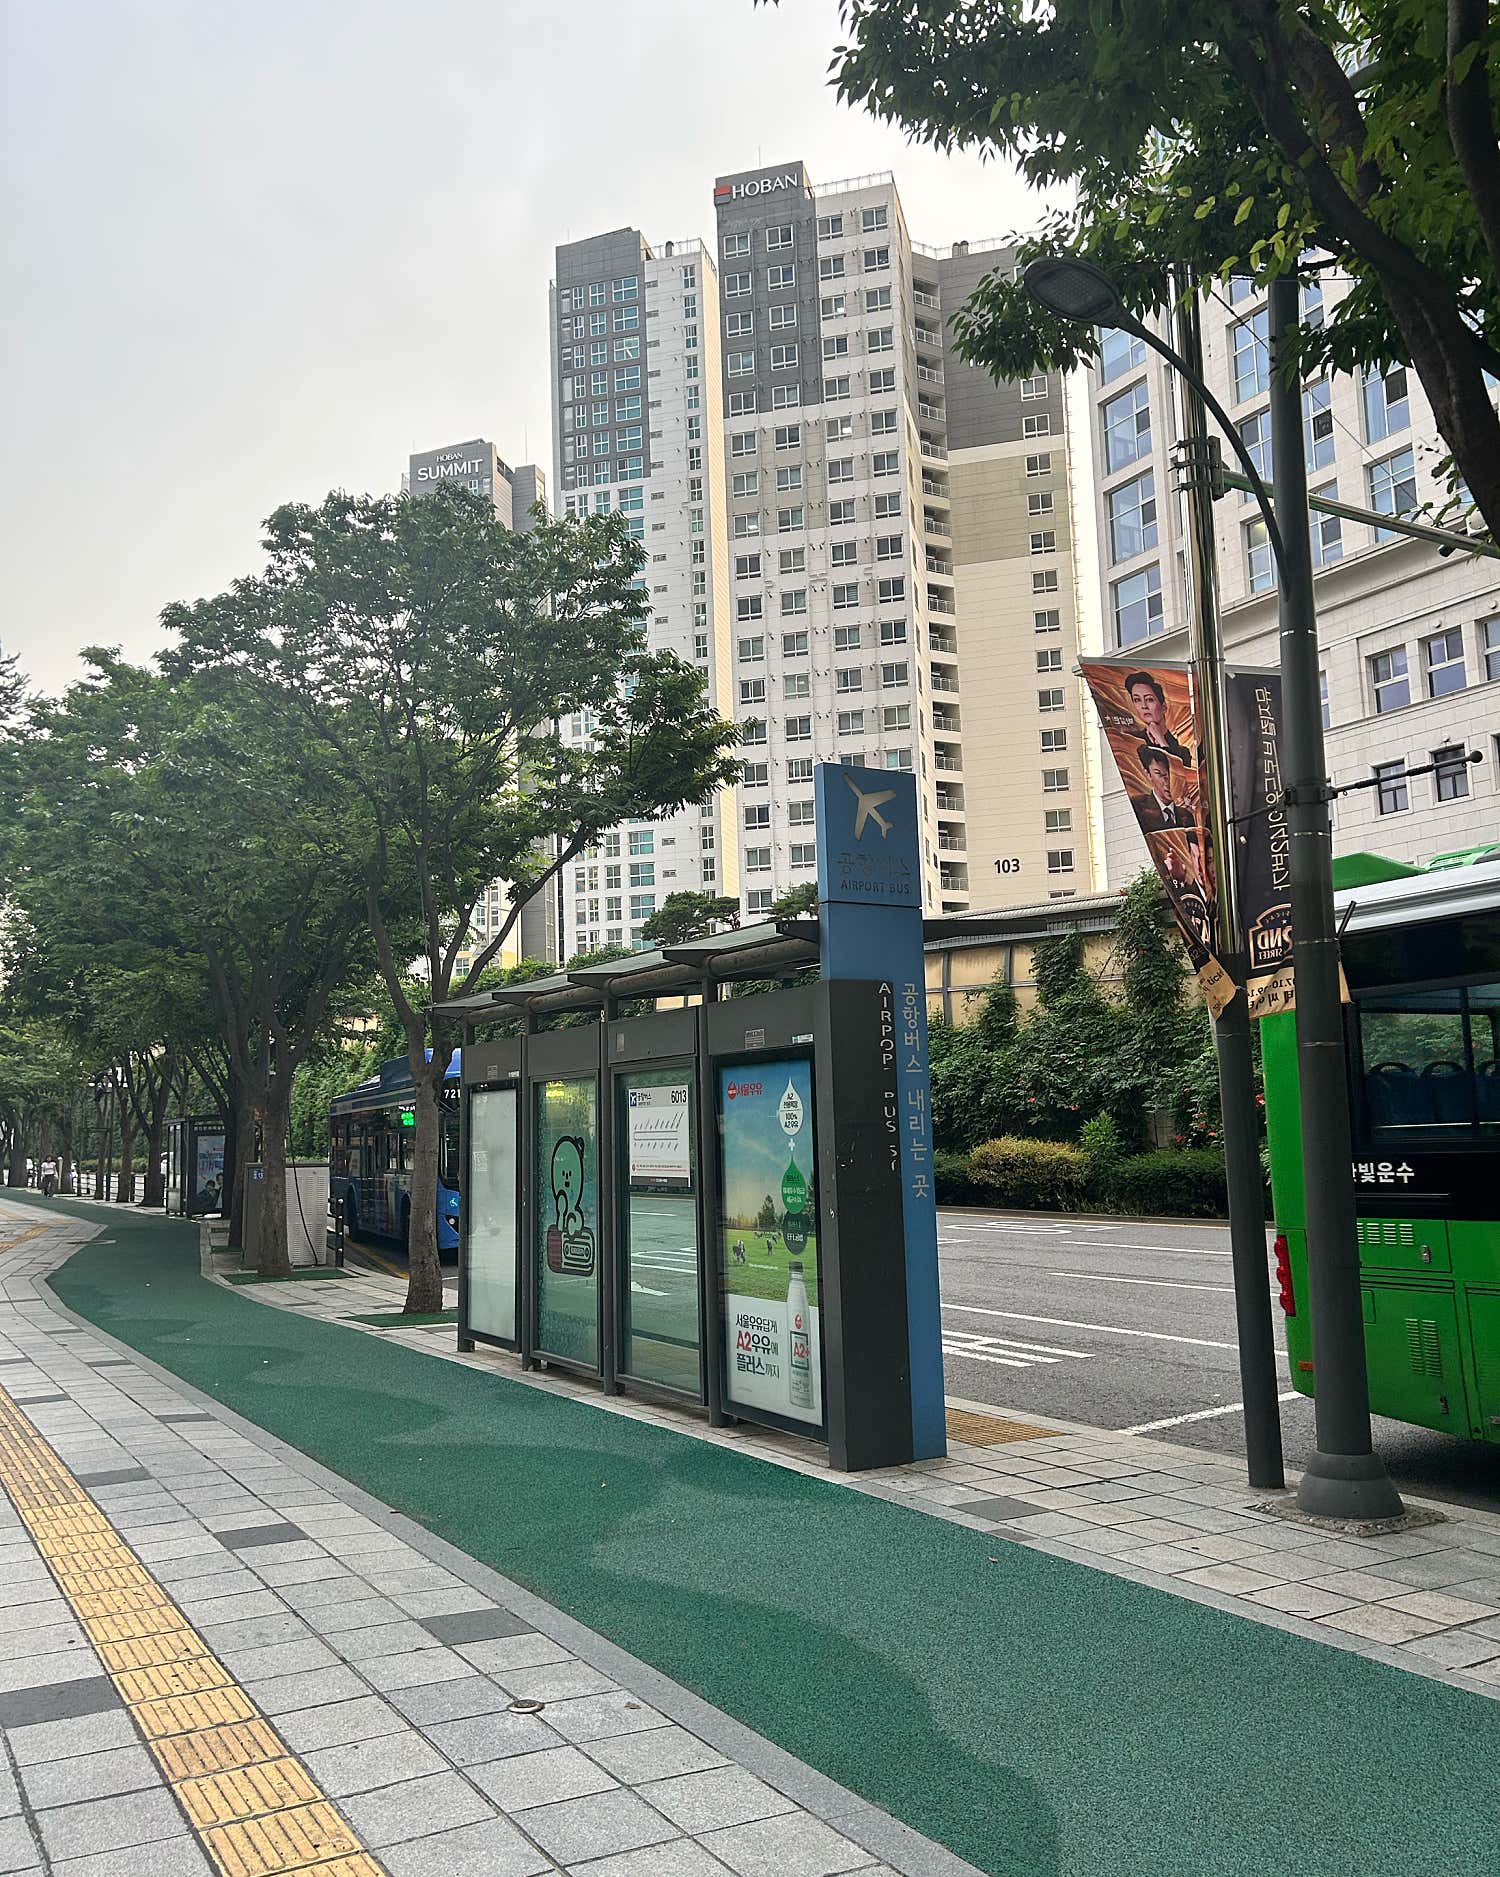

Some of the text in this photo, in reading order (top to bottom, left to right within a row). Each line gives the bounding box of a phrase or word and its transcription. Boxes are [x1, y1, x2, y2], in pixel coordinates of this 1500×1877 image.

[732, 173, 798, 199] HOBAN
[436, 452, 463, 462] HOBAN
[417, 459, 483, 481] SUMMIT
[837, 852, 911, 876] 공항스
[994, 858, 1021, 874] 103
[840, 879, 910, 895] AIRPORT BUS
[444, 1089, 461, 1099] 721
[671, 1090, 687, 1104] 6013
[901, 983, 930, 1199] 공항버스 내리는 곳
[736, 1313, 778, 1335] 서울우유답게
[737, 1330, 779, 1356] A2우유에
[737, 1353, 780, 1380] 플러스까지
